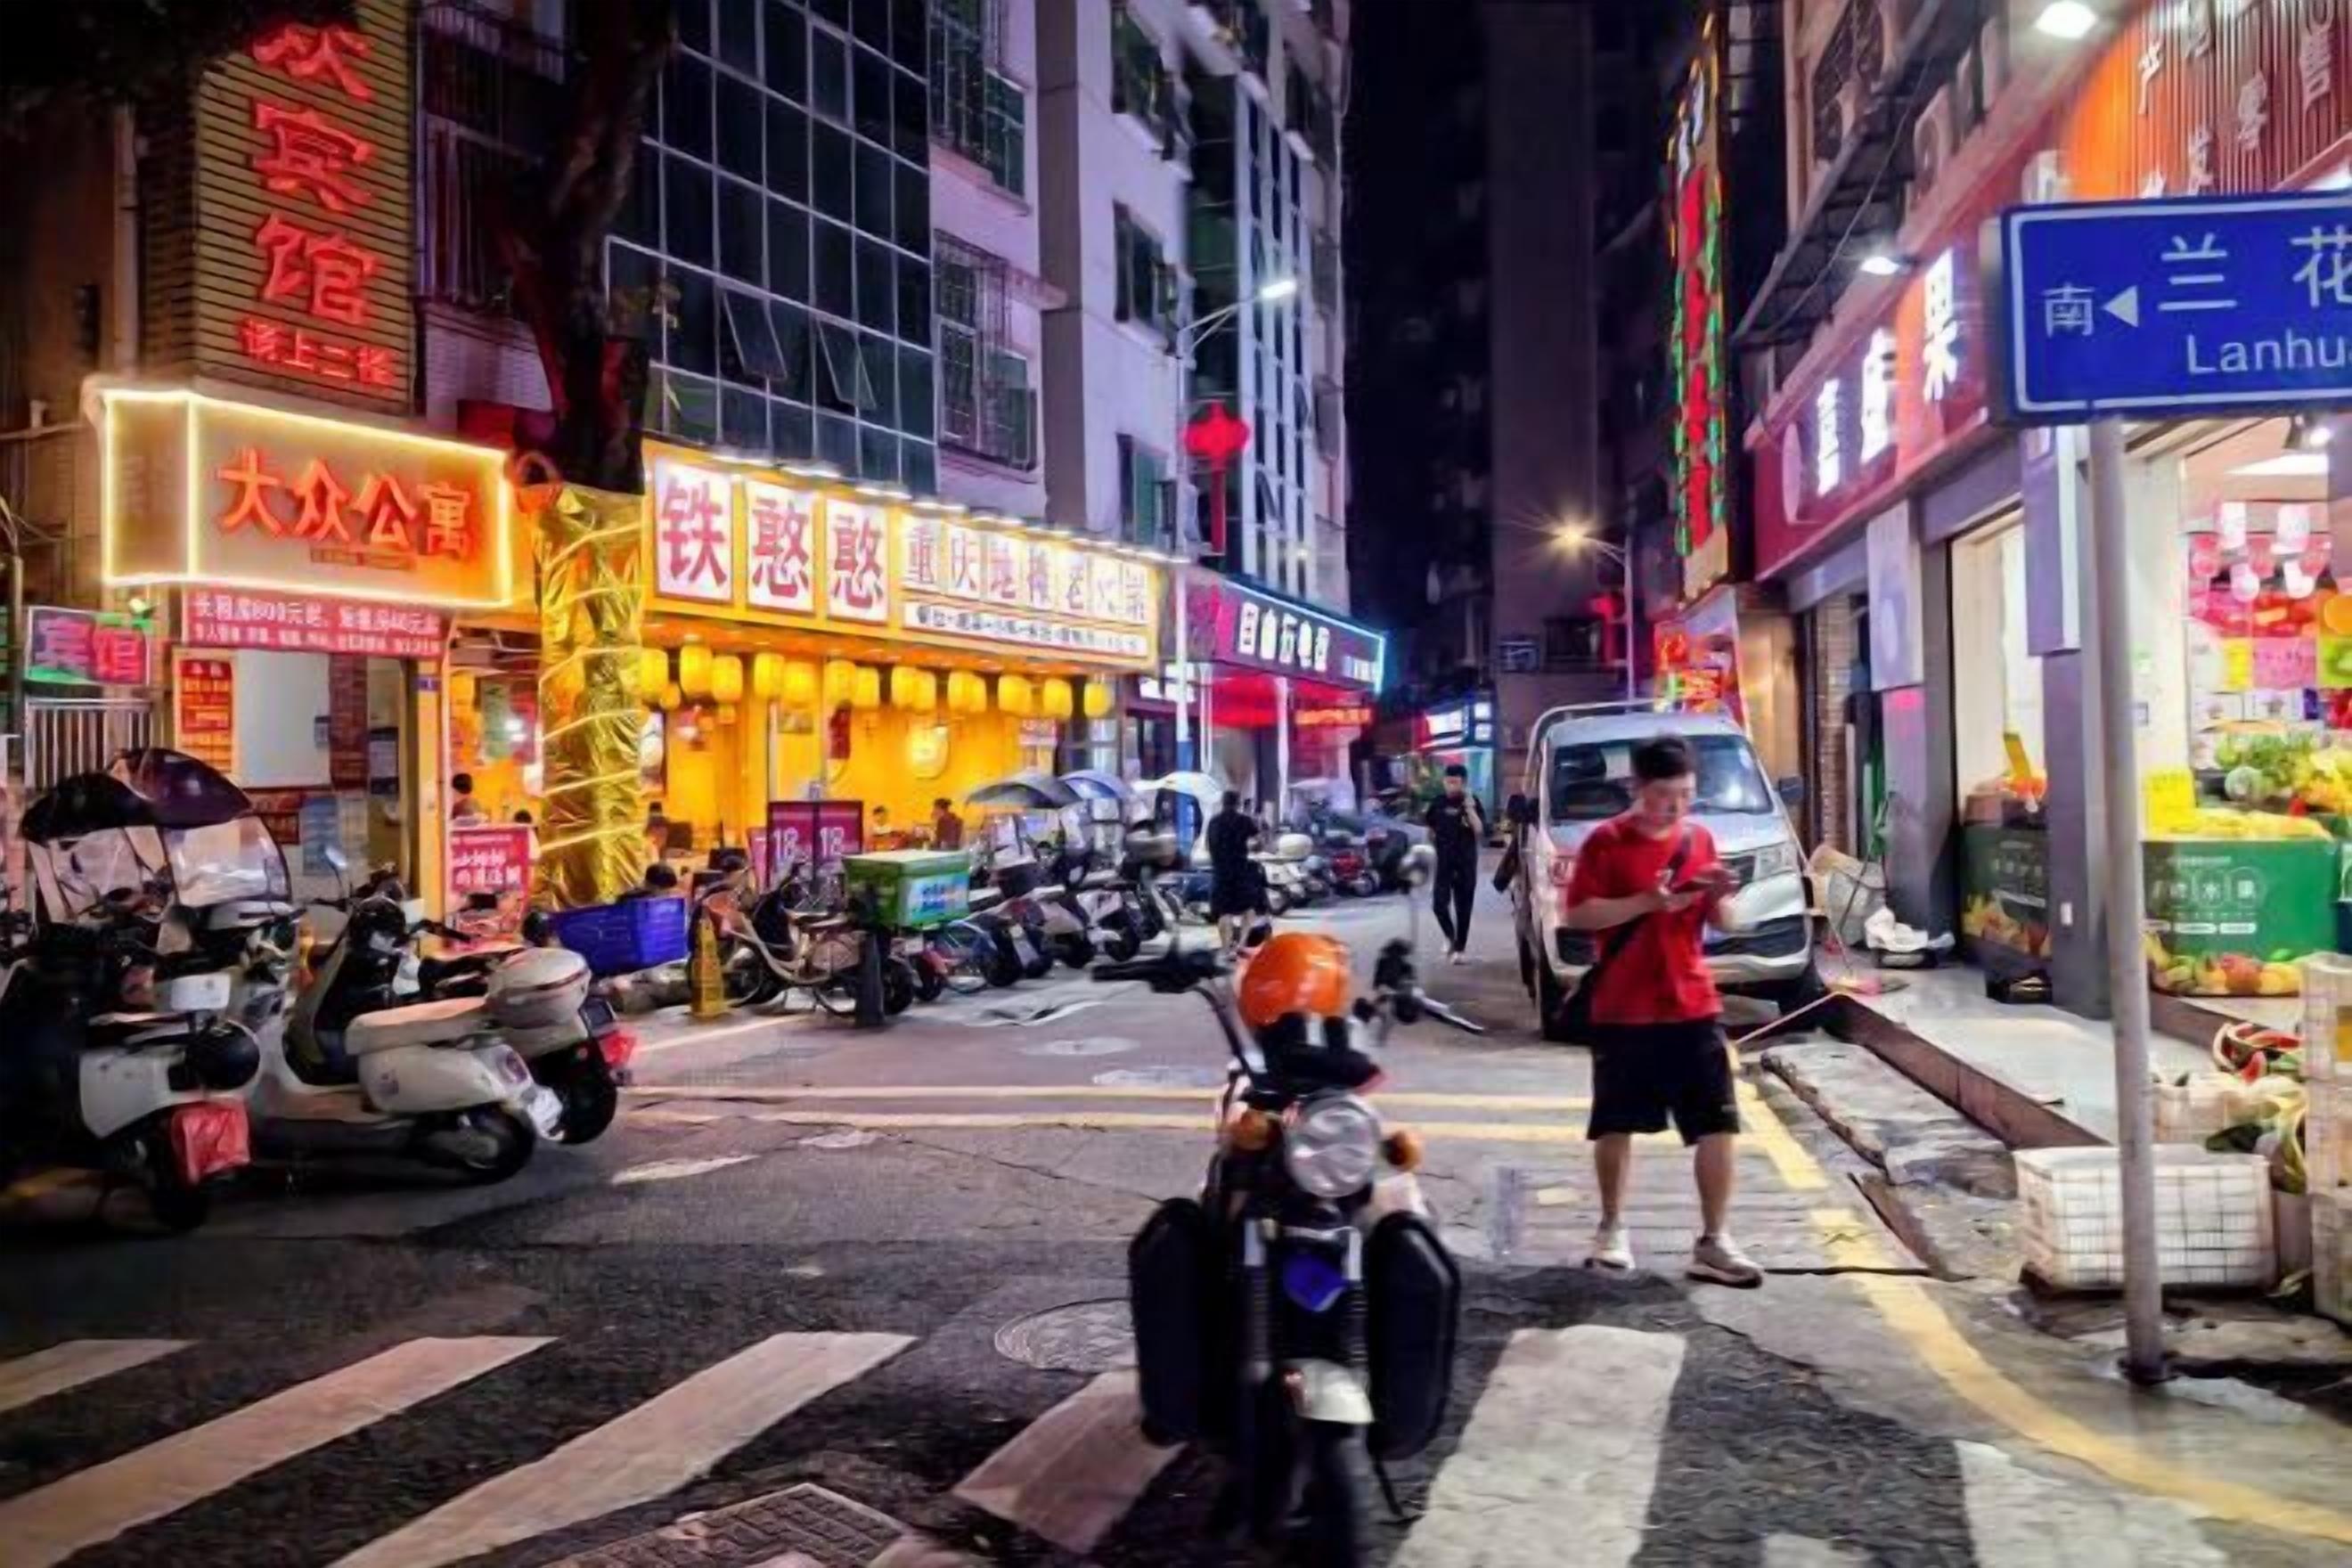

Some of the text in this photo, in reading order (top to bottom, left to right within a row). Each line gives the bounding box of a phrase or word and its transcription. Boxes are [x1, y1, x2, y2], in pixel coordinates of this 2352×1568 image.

[2042, 283, 2094, 338] 南
[2186, 329, 2352, 374] Lanhu
[216, 446, 470, 559] 大众公寓
[661, 479, 884, 610] 铁憨憨
